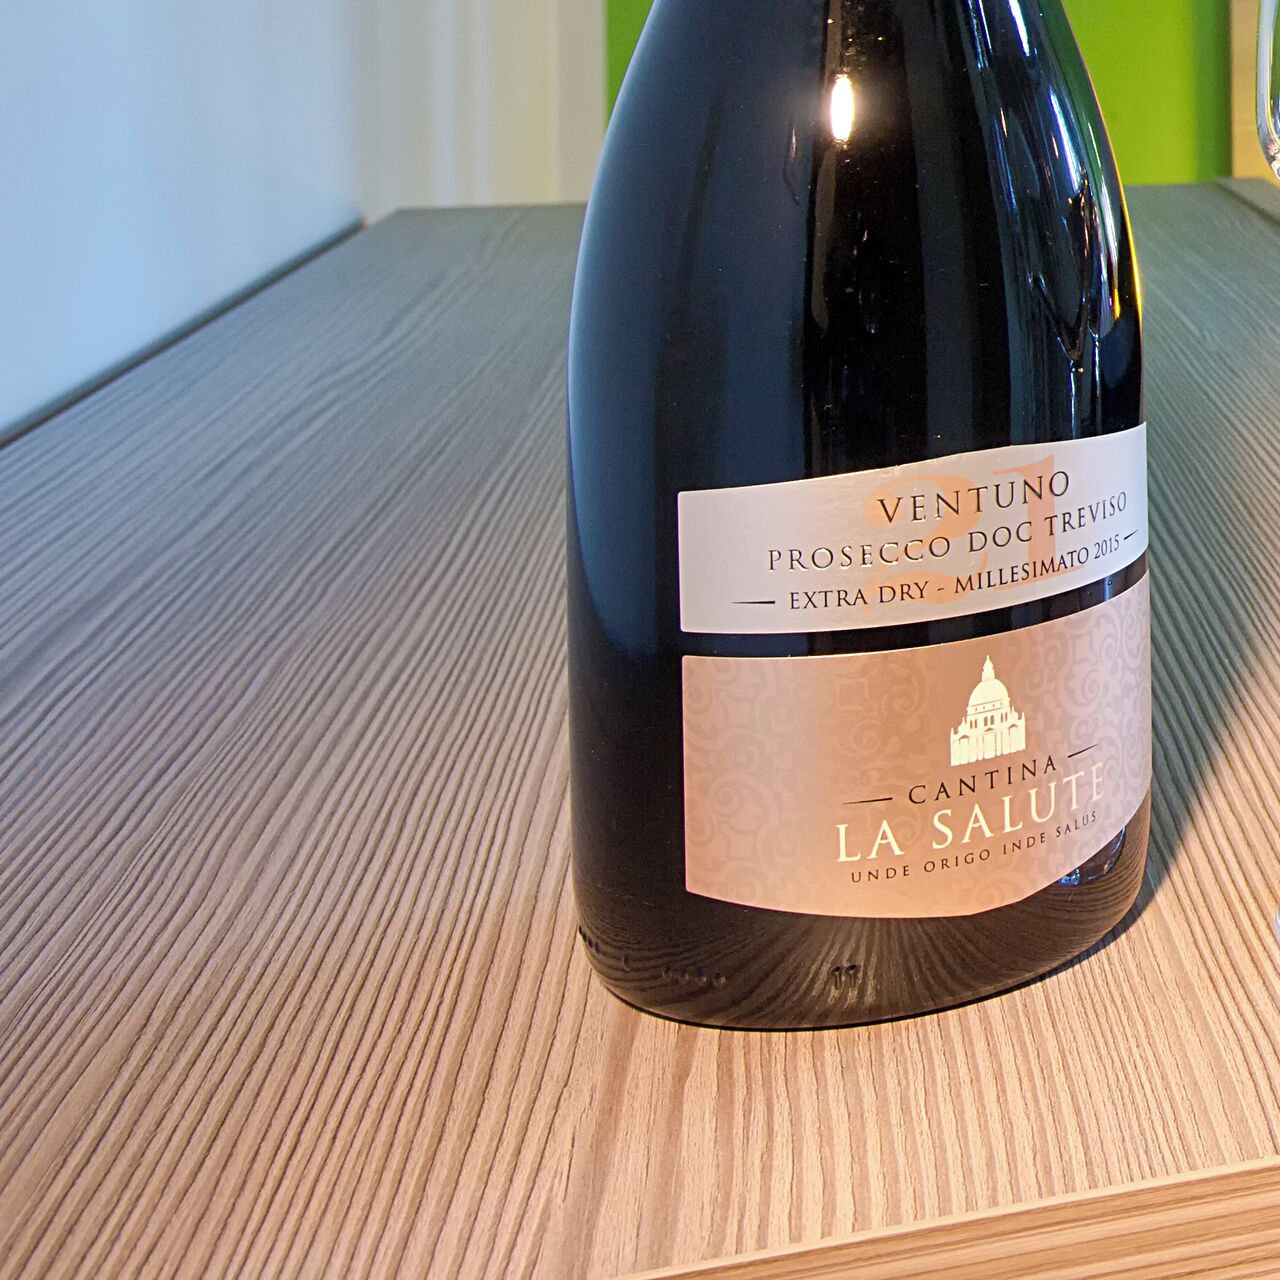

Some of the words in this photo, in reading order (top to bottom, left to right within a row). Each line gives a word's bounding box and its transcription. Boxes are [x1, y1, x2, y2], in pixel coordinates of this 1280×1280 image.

[767, 534, 951, 571] PROSECCO
[968, 520, 1033, 554] DOC
[1044, 490, 1128, 537] TREVISO
[878, 470, 1069, 523] VENTUNO
[789, 590, 869, 610] EXTRA
[879, 580, 929, 604] DRY
[954, 546, 1090, 594] MILLESIMATO
[1094, 533, 1121, 561] 2015
[837, 820, 904, 863] LA
[932, 761, 1104, 849] SALUTE
[908, 753, 1057, 805] CANTINA
[851, 865, 911, 883] UNDE
[923, 847, 992, 873] ORIGO
[1002, 831, 1047, 856] INDE
[1055, 809, 1098, 838] SALUS
